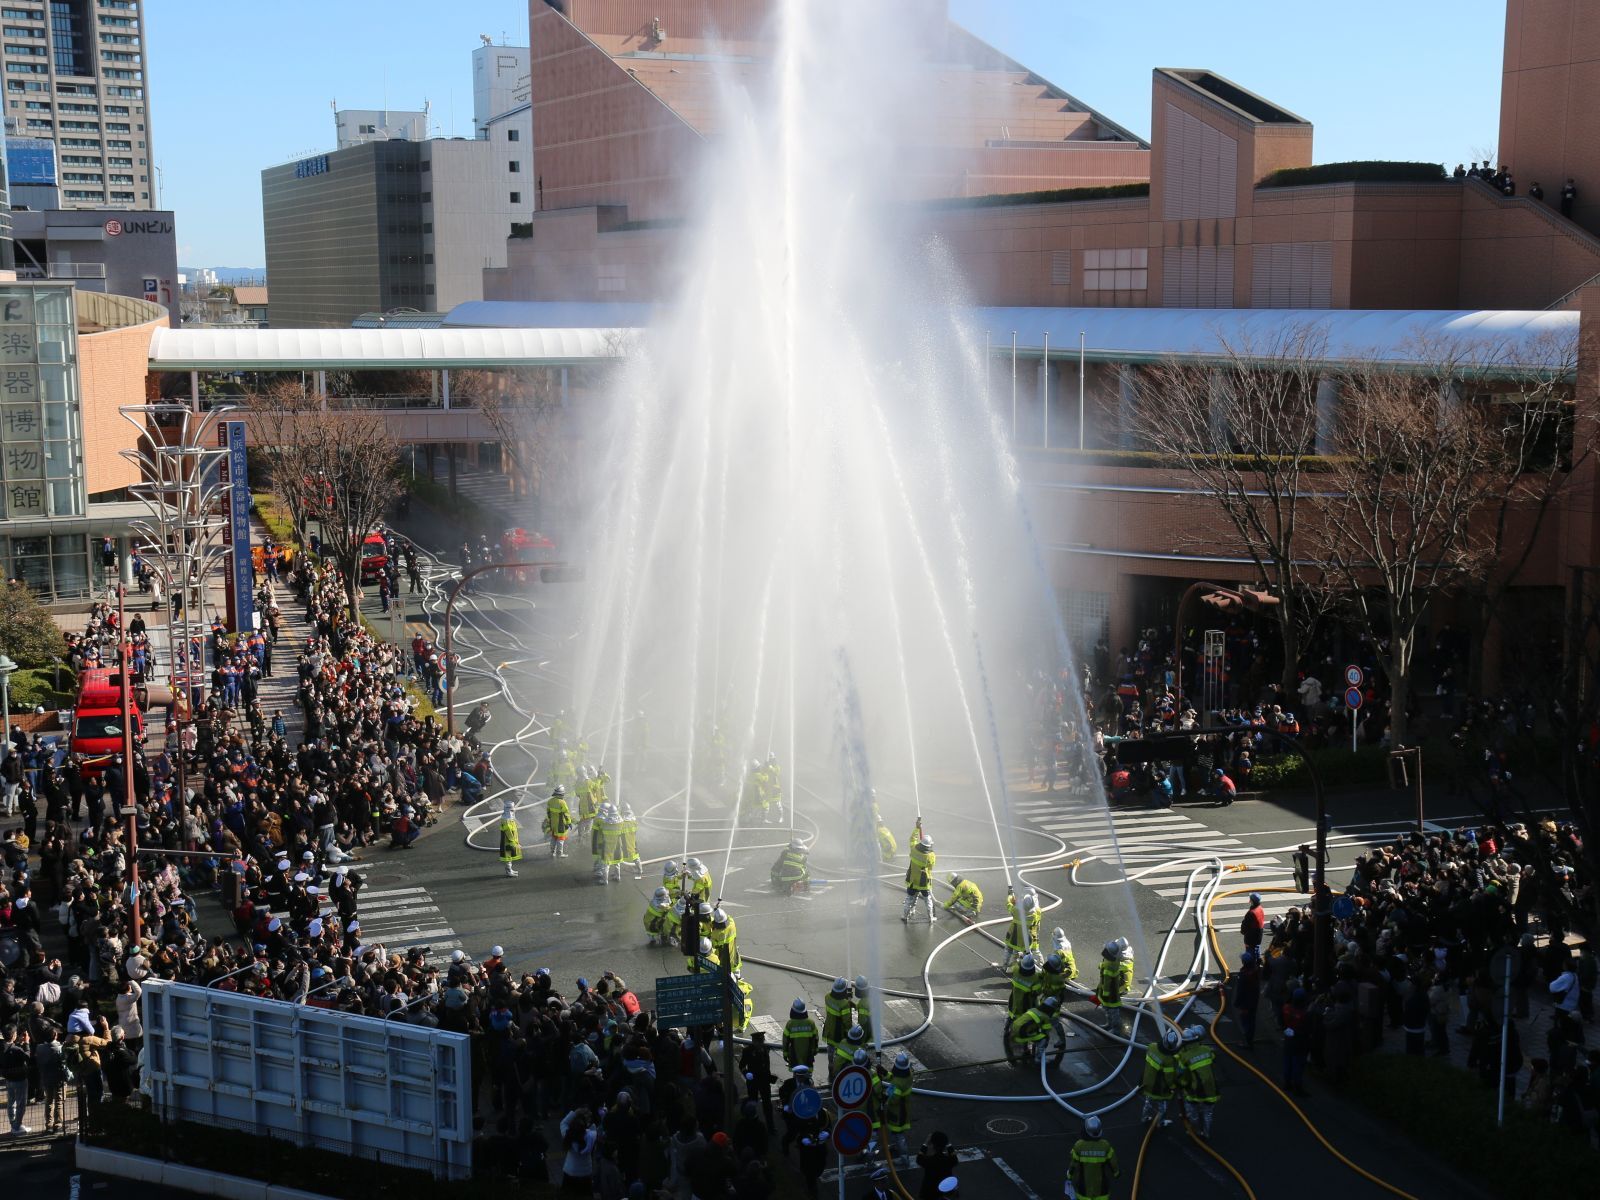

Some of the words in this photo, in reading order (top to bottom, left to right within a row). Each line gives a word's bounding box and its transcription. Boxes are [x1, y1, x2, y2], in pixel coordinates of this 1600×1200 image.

[497, 56, 518, 77] P
[124, 220, 172, 234] UNビル
[145, 281, 155, 290] P
[1, 332, 41, 509] 楽器博物館
[233, 439, 247, 540] 浜松市楽器博物館
[1350, 671, 1358, 681] 40
[842, 1078, 864, 1098] 40
